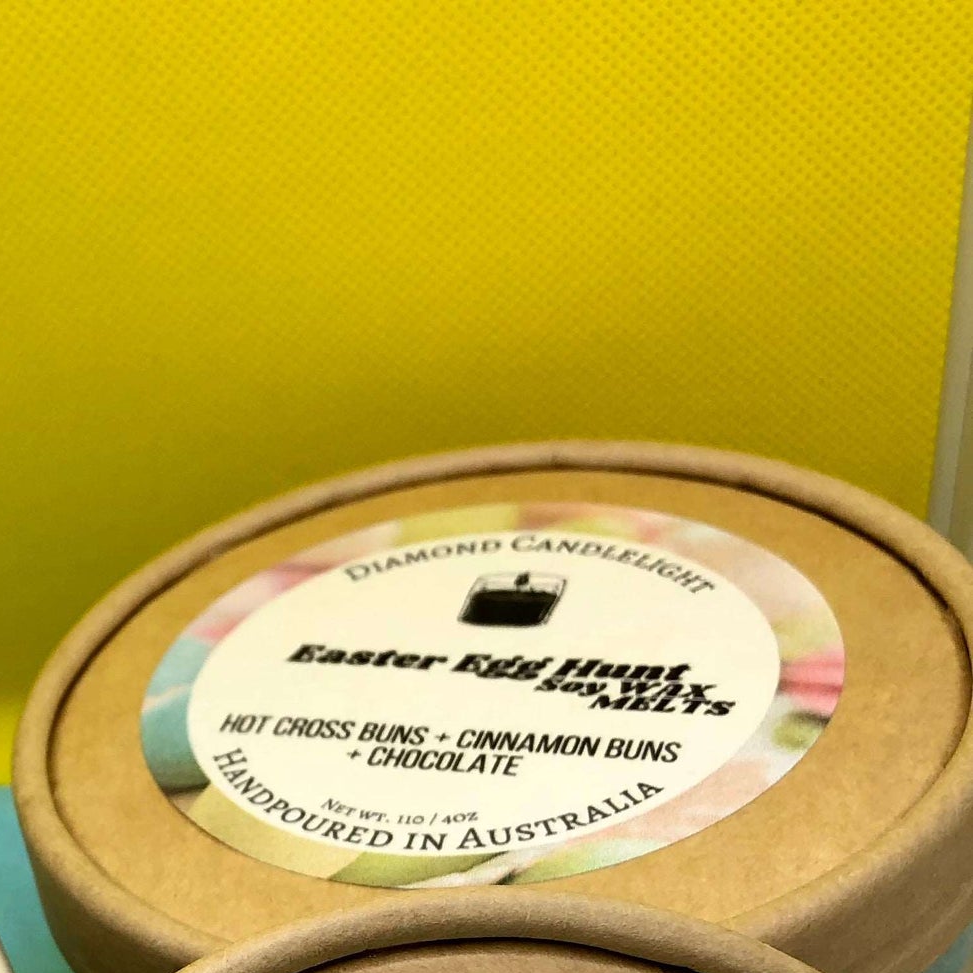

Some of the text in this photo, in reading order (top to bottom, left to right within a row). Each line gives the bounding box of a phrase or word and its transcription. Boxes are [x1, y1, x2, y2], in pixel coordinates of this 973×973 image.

[287, 643, 691, 681] Easter Egg Hunt
[534, 676, 717, 701] Soy WAX
[588, 695, 736, 716] MELTS
[220, 714, 682, 763] HOT CROSS BUNS + CINNAMON BUNS
[347, 745, 523, 776] + CHOCOLATE
[429, 813, 438, 825] /
